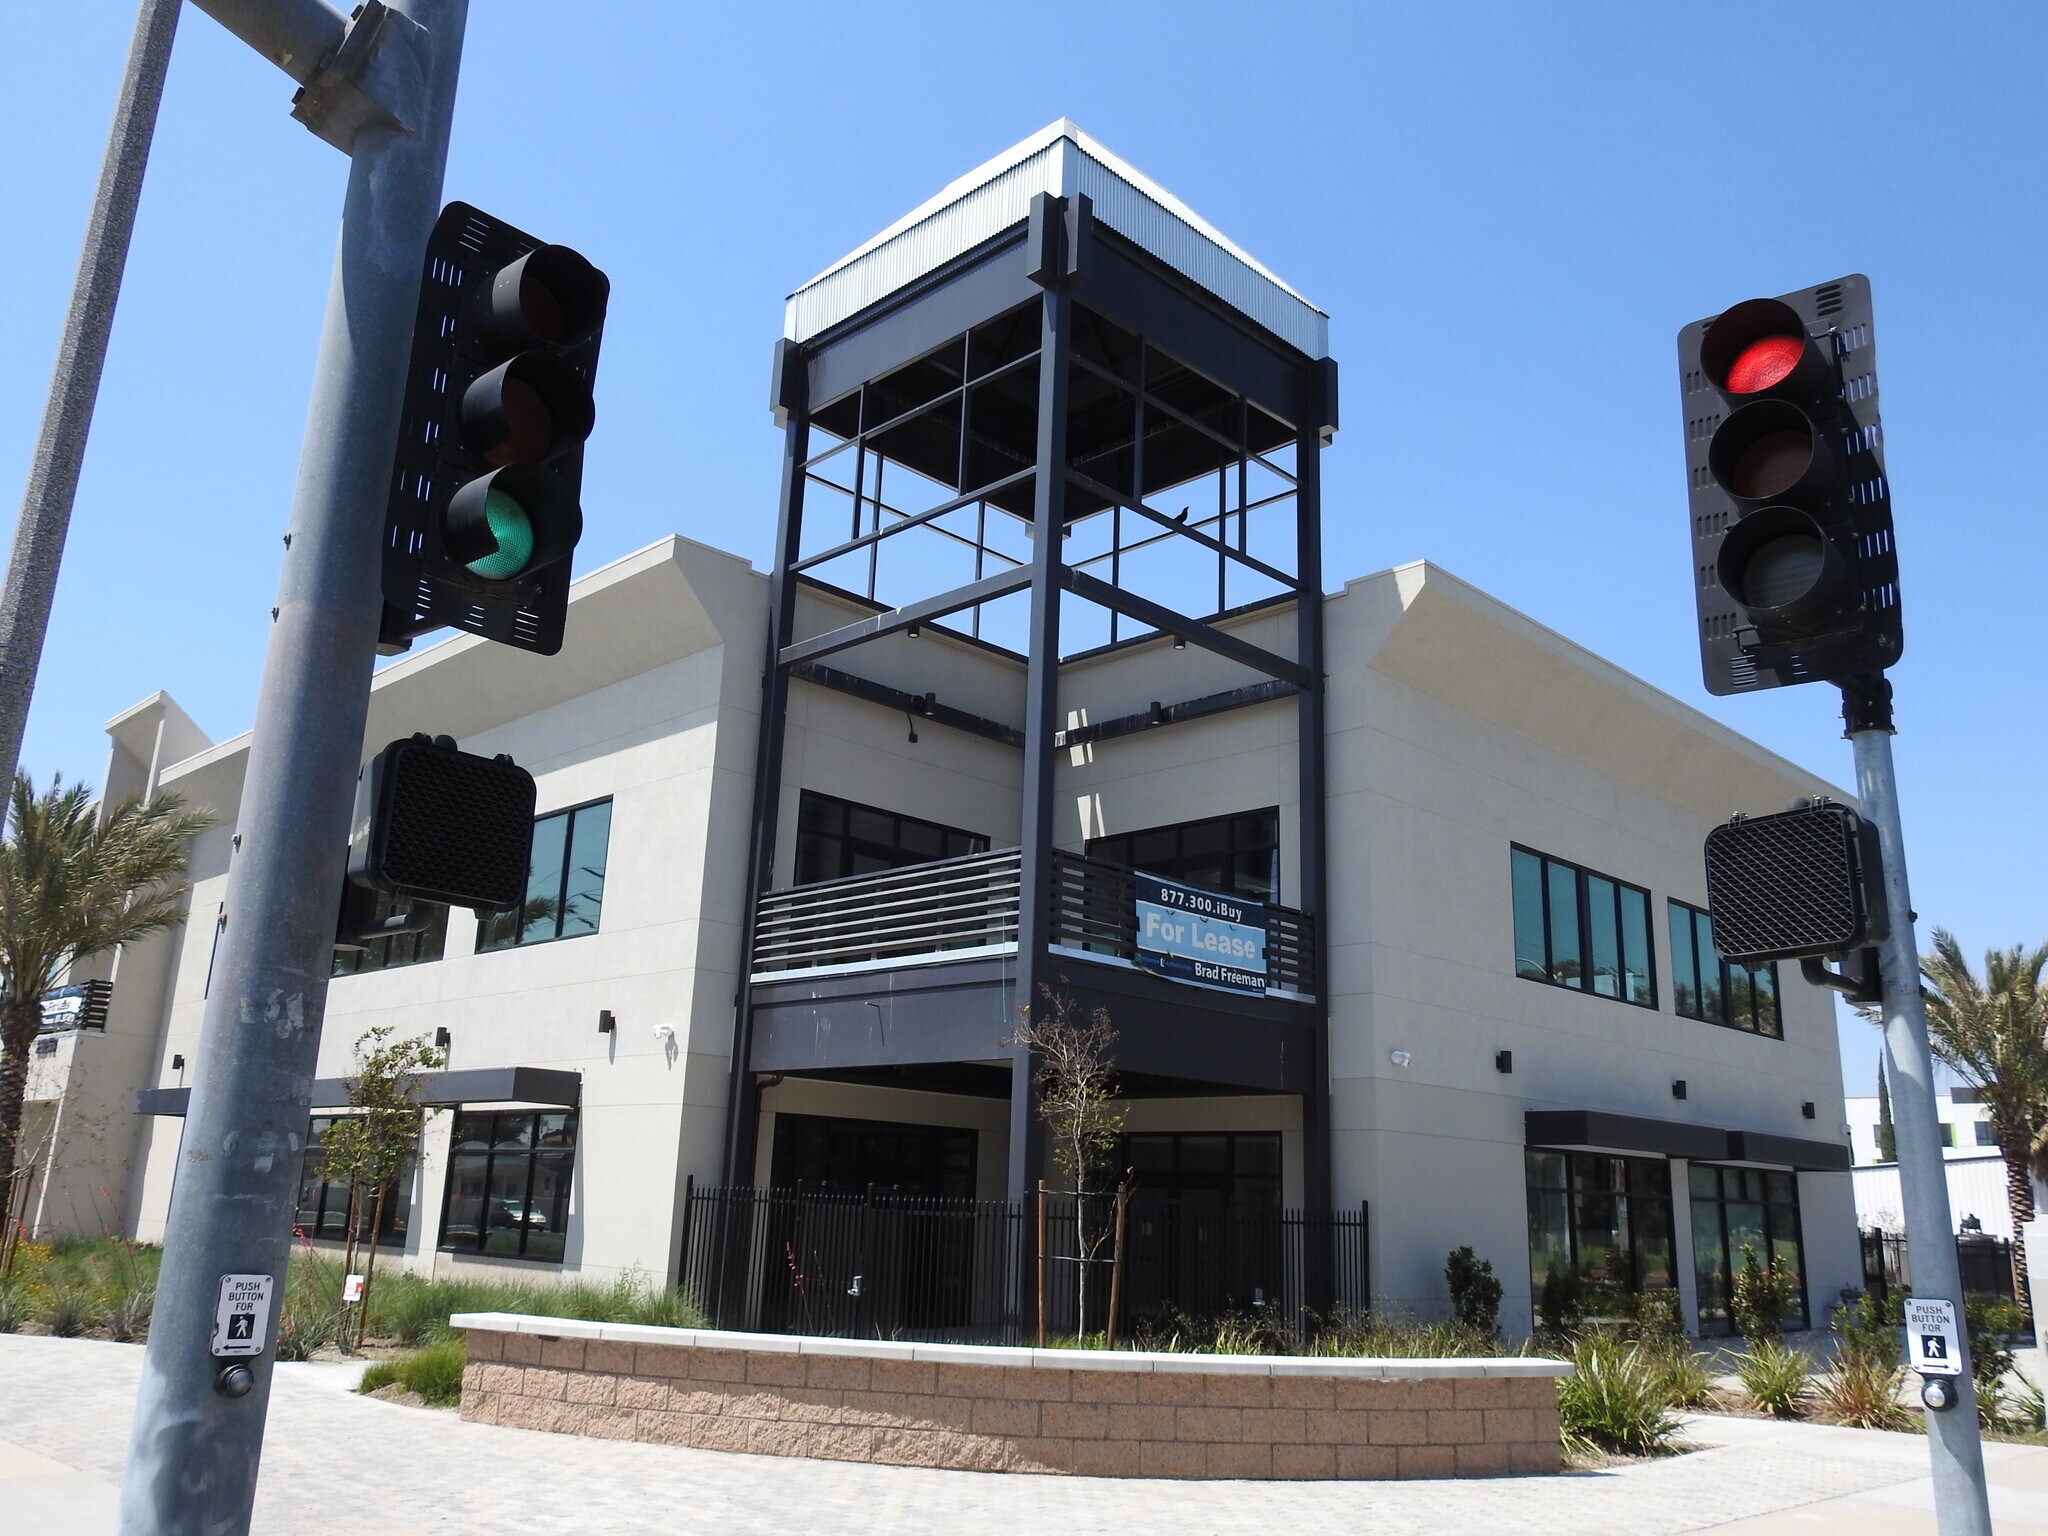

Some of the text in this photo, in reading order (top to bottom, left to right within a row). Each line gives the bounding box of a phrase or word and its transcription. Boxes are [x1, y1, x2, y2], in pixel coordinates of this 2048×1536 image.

[1161, 888, 1242, 922] 877.300.iBuy
[1146, 912, 1256, 959] For Lease
[1195, 962, 1219, 980] Brad
[1221, 968, 1265, 988] Freeman
[235, 1282, 260, 1291] PUSH
[228, 1292, 264, 1301] BUTTON
[235, 1302, 254, 1311] FOR
[1916, 1306, 1943, 1314] PUSH
[1911, 1314, 1950, 1324] BUTTON
[1922, 1324, 1942, 1333] FOR
